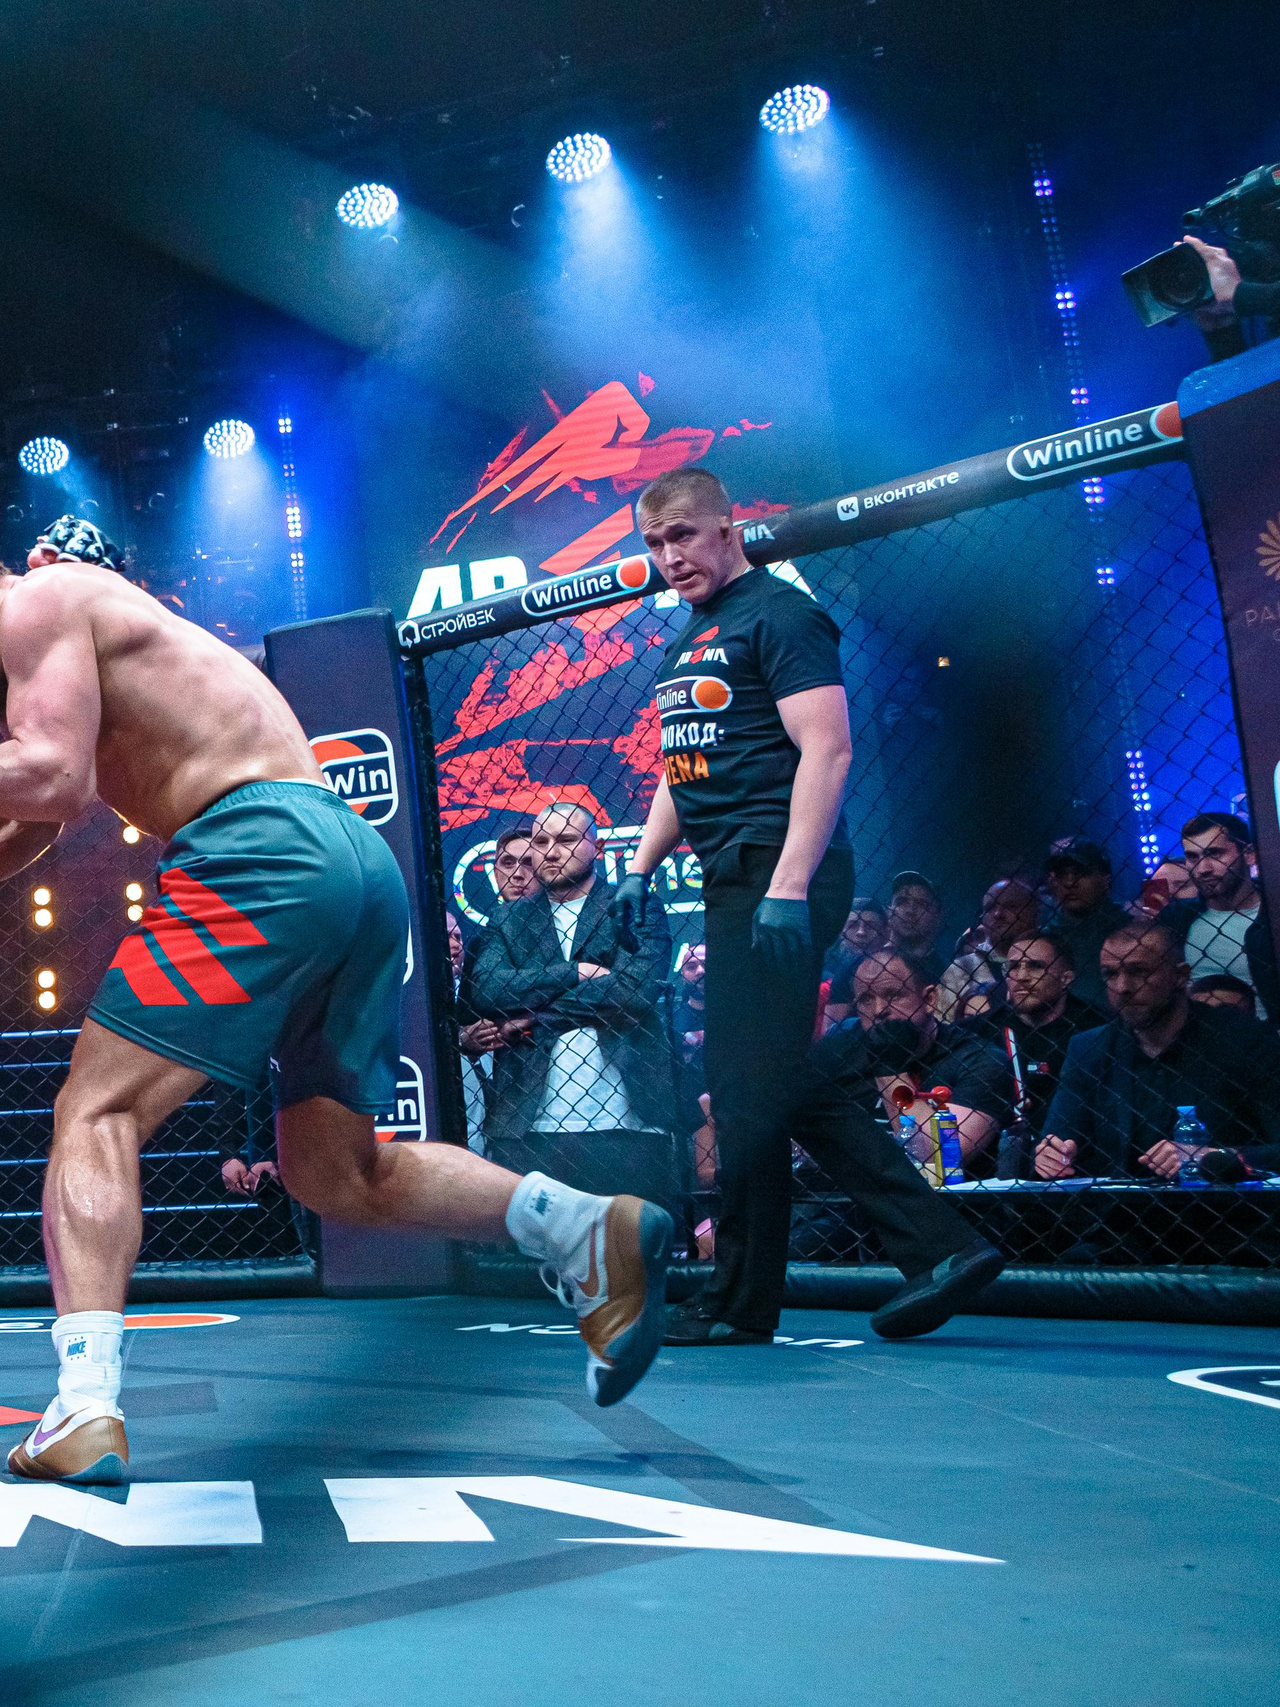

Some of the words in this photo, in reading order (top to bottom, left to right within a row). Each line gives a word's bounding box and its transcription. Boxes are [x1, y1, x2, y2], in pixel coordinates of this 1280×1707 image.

[1023, 423, 1144, 469] Winline
[532, 574, 613, 608] Winline
[421, 607, 496, 639] СТРОЙВЕК
[674, 645, 730, 670] ARENA
[323, 765, 389, 795] Win
